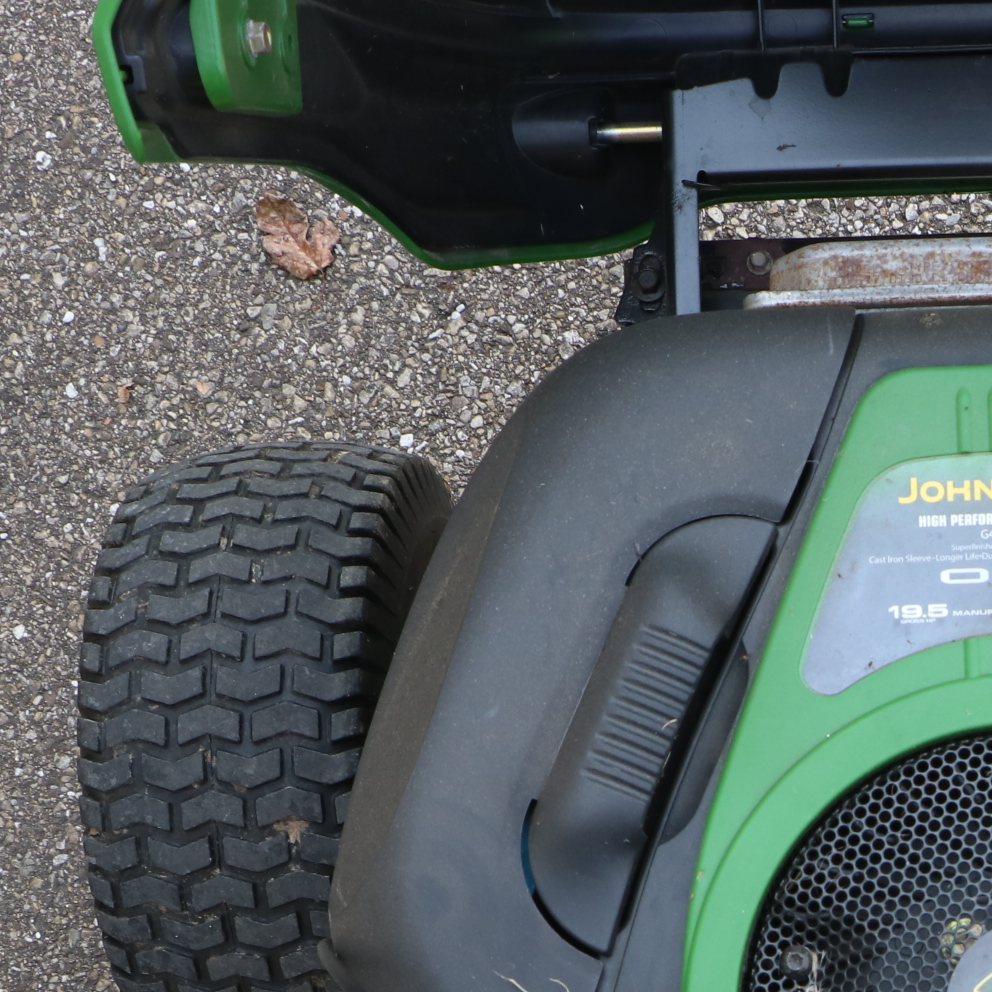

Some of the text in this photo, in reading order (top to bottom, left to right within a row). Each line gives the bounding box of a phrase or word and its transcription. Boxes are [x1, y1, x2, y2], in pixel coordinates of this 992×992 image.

[919, 515, 946, 527] HIGH
[868, 556, 886, 564] Cast
[888, 603, 948, 619] 19.5
